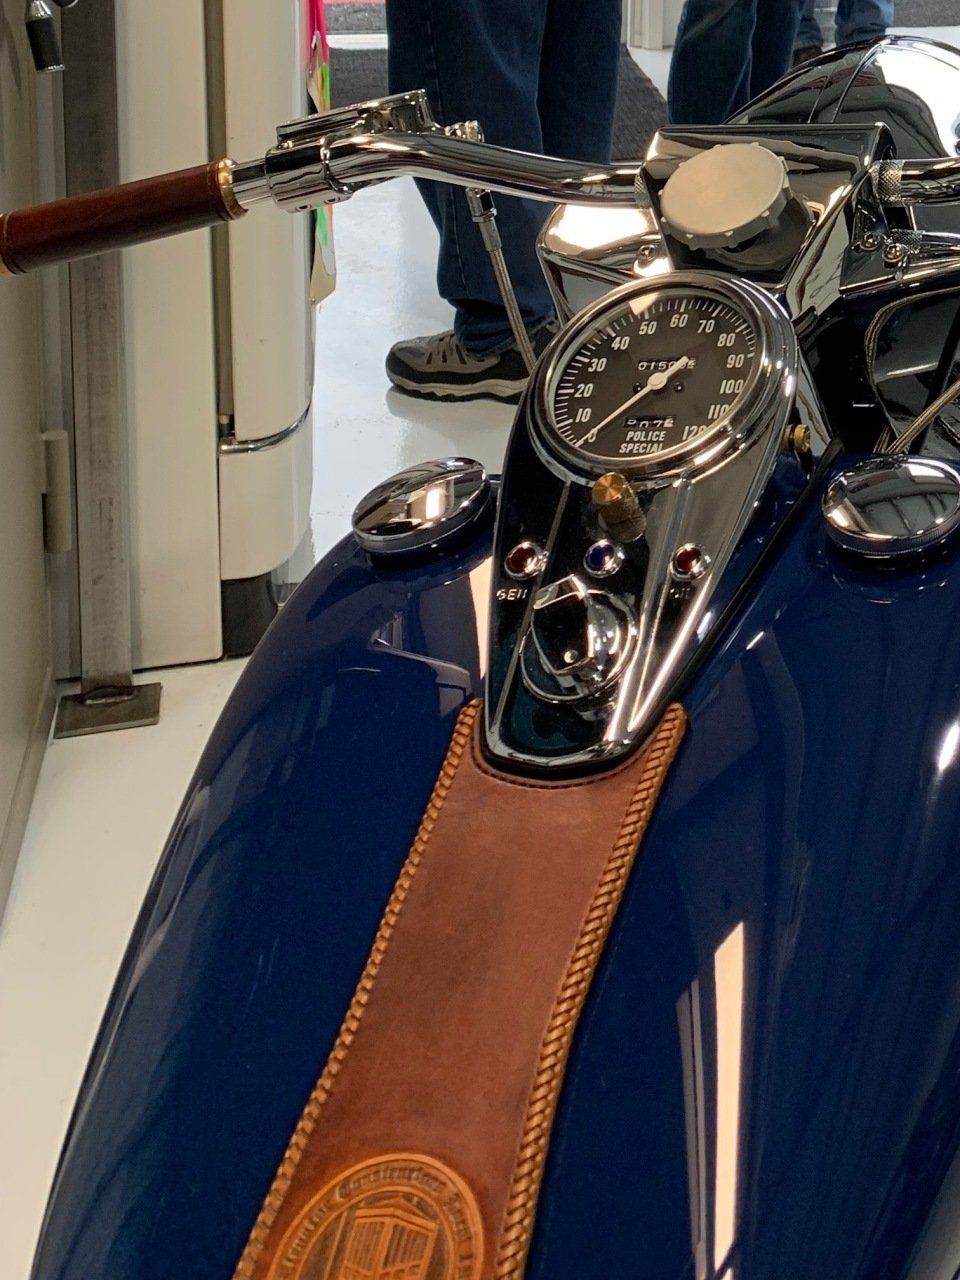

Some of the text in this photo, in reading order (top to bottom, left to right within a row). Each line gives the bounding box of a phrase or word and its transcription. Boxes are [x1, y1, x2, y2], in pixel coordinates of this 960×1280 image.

[670, 314, 688, 328] 60
[697, 320, 715, 334] 70
[639, 322, 657, 335] 50
[611, 336, 630, 350] 40
[717, 333, 735, 347] 80
[588, 358, 607, 371] 30
[726, 354, 745, 368] 90
[574, 383, 594, 398] 20
[720, 379, 744, 394] 100
[576, 408, 591, 422] 10
[626, 431, 666, 442] POLICE
[619, 443, 663, 454] SPECIAL
